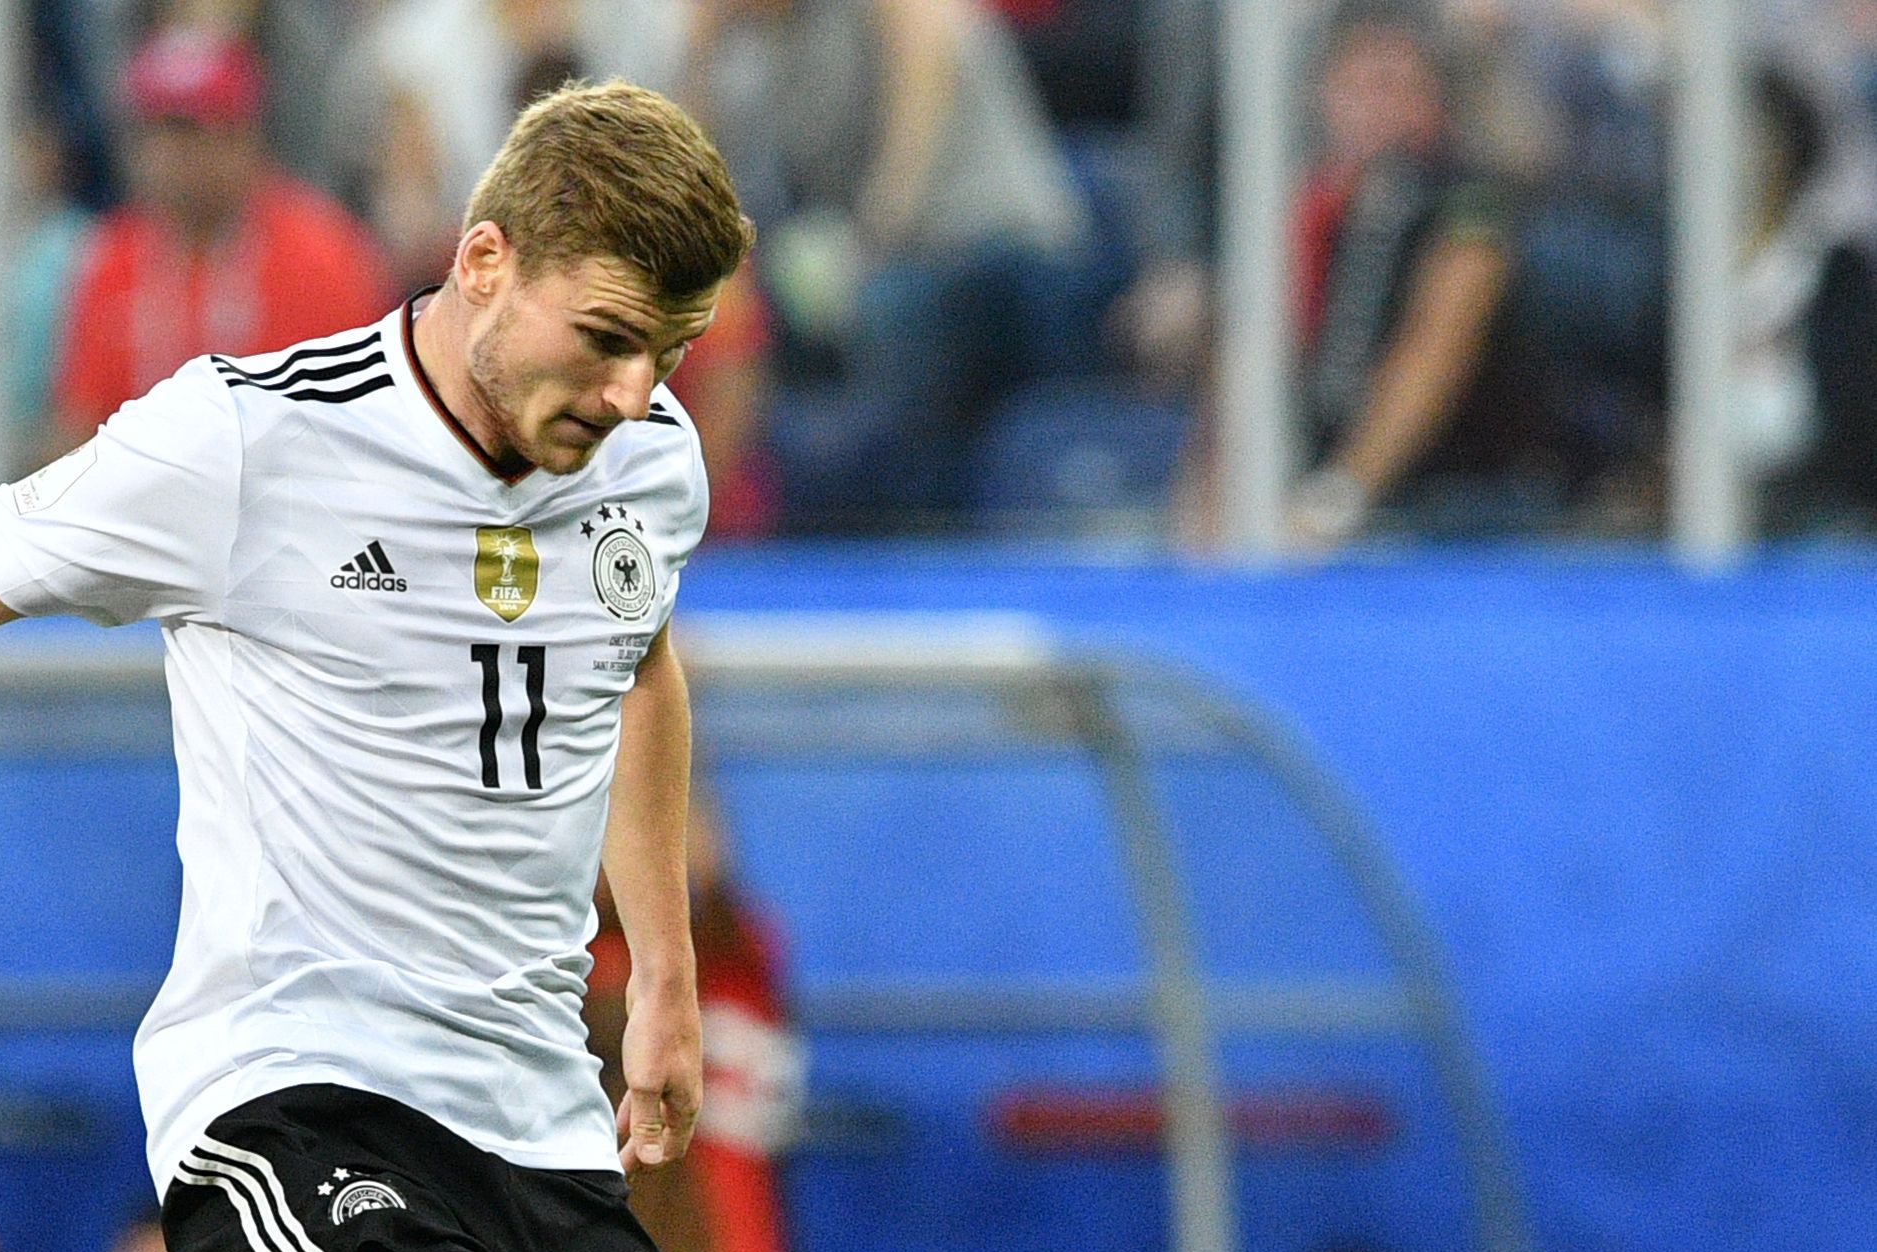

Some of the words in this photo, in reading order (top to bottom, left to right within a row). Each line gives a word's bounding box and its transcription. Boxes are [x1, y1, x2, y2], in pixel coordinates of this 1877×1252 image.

[330, 572, 408, 592] adidas
[491, 586, 521, 600] FIFA
[471, 643, 547, 789] 11
